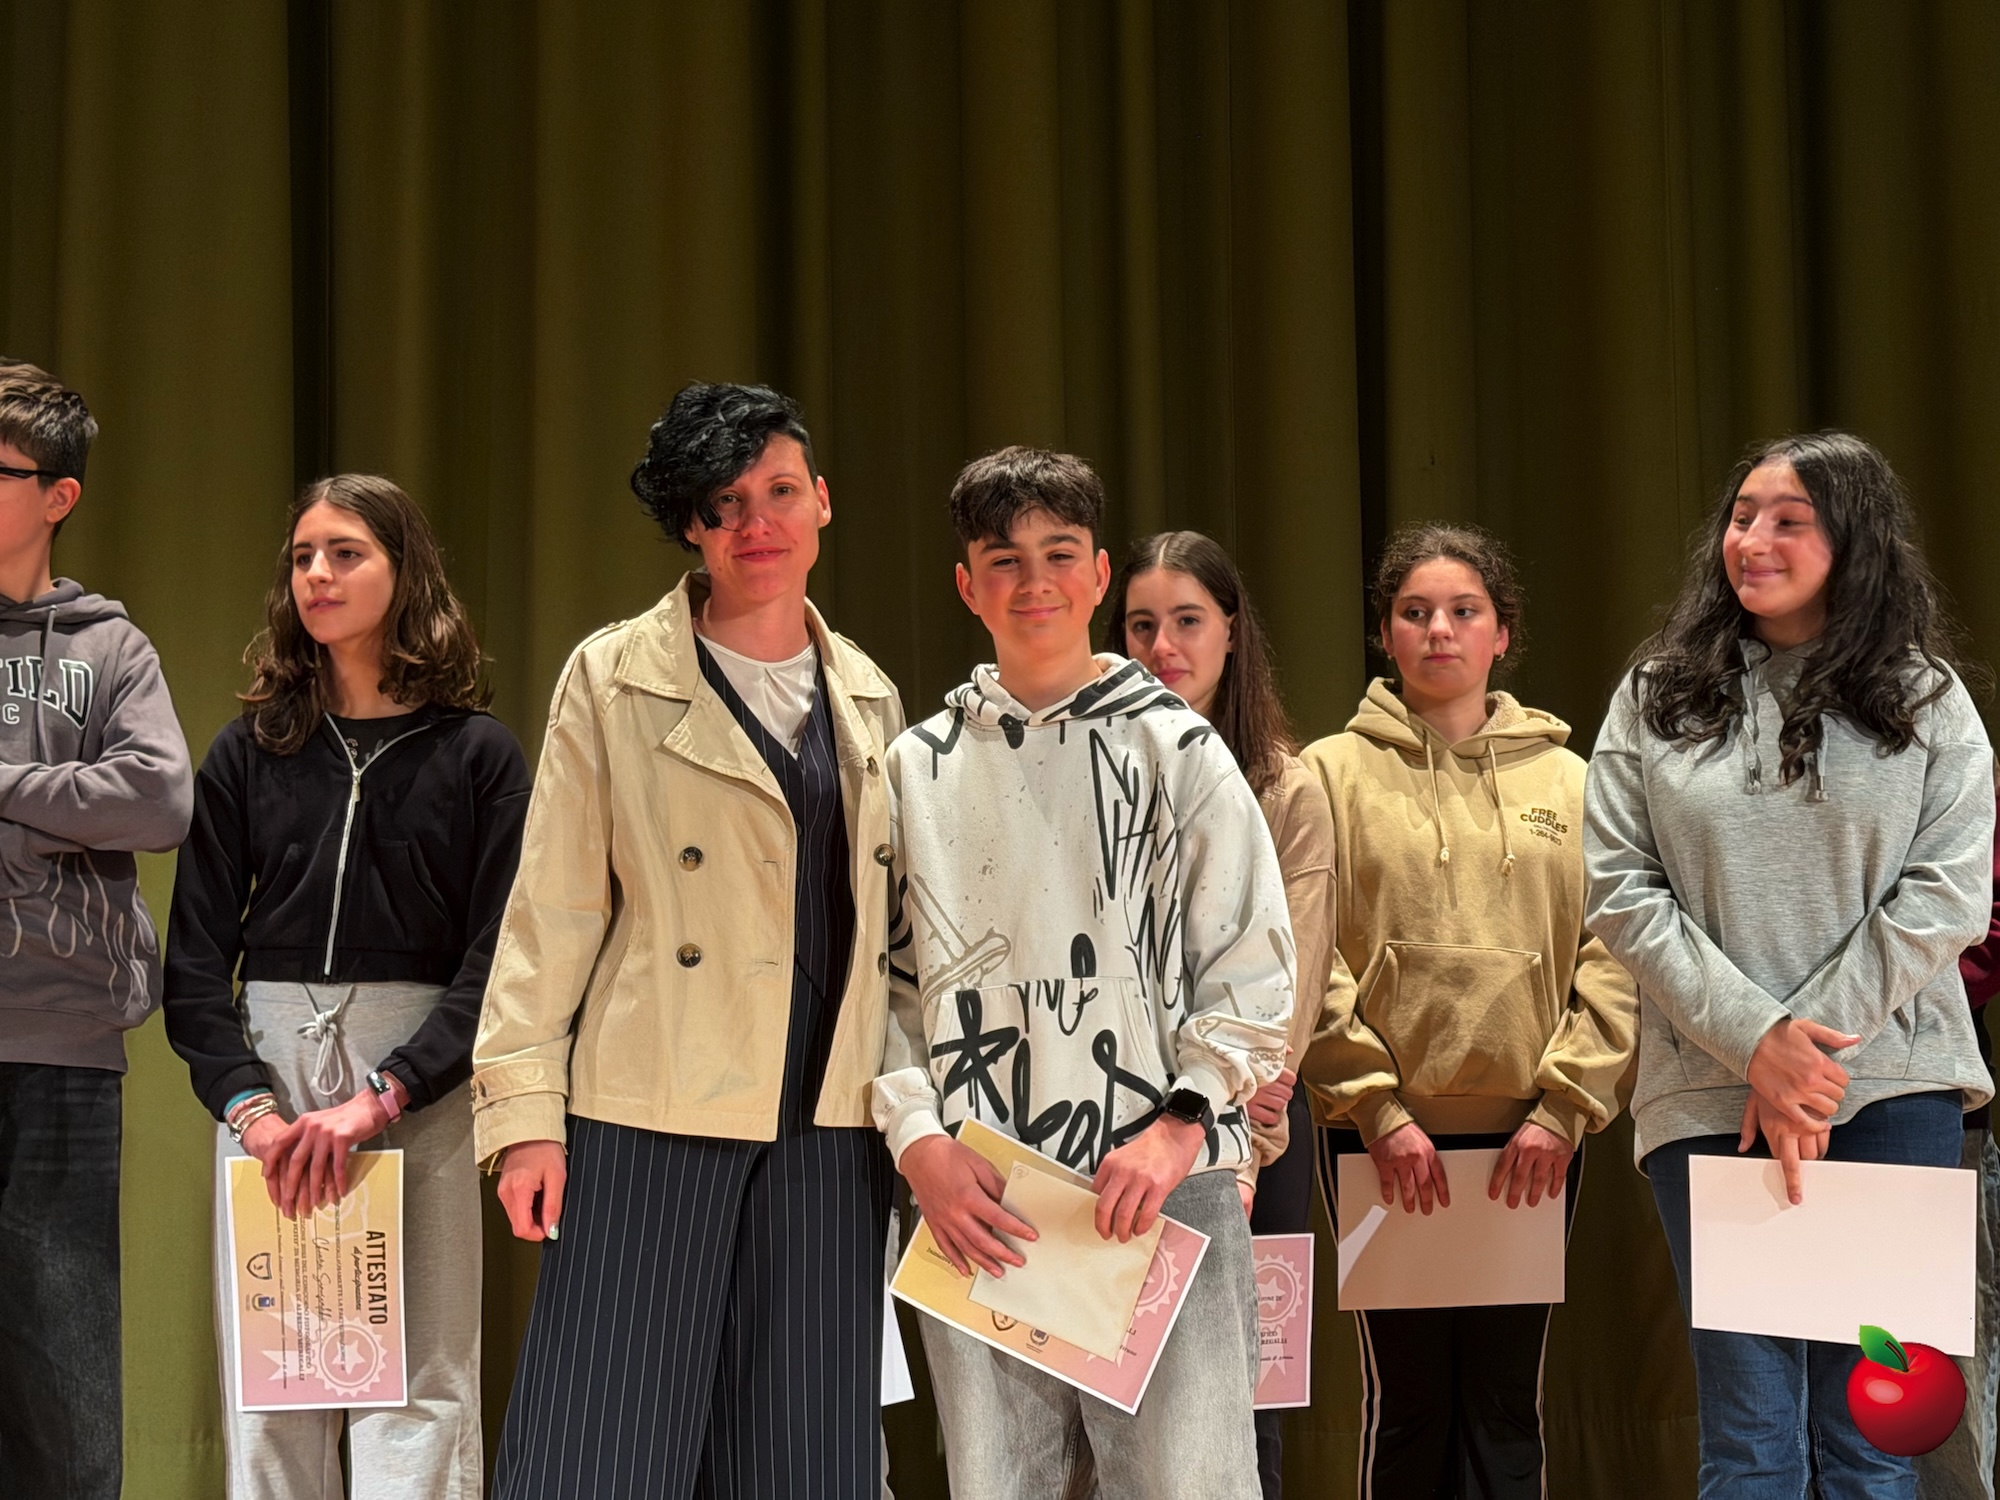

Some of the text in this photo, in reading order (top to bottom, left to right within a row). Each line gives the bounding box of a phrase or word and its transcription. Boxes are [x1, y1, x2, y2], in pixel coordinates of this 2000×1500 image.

[0, 656, 93, 731] ILD
[1520, 813, 1568, 834] CUDDLES
[1531, 808, 1558, 821] FREE
[365, 1230, 389, 1324] ATTESTATO
